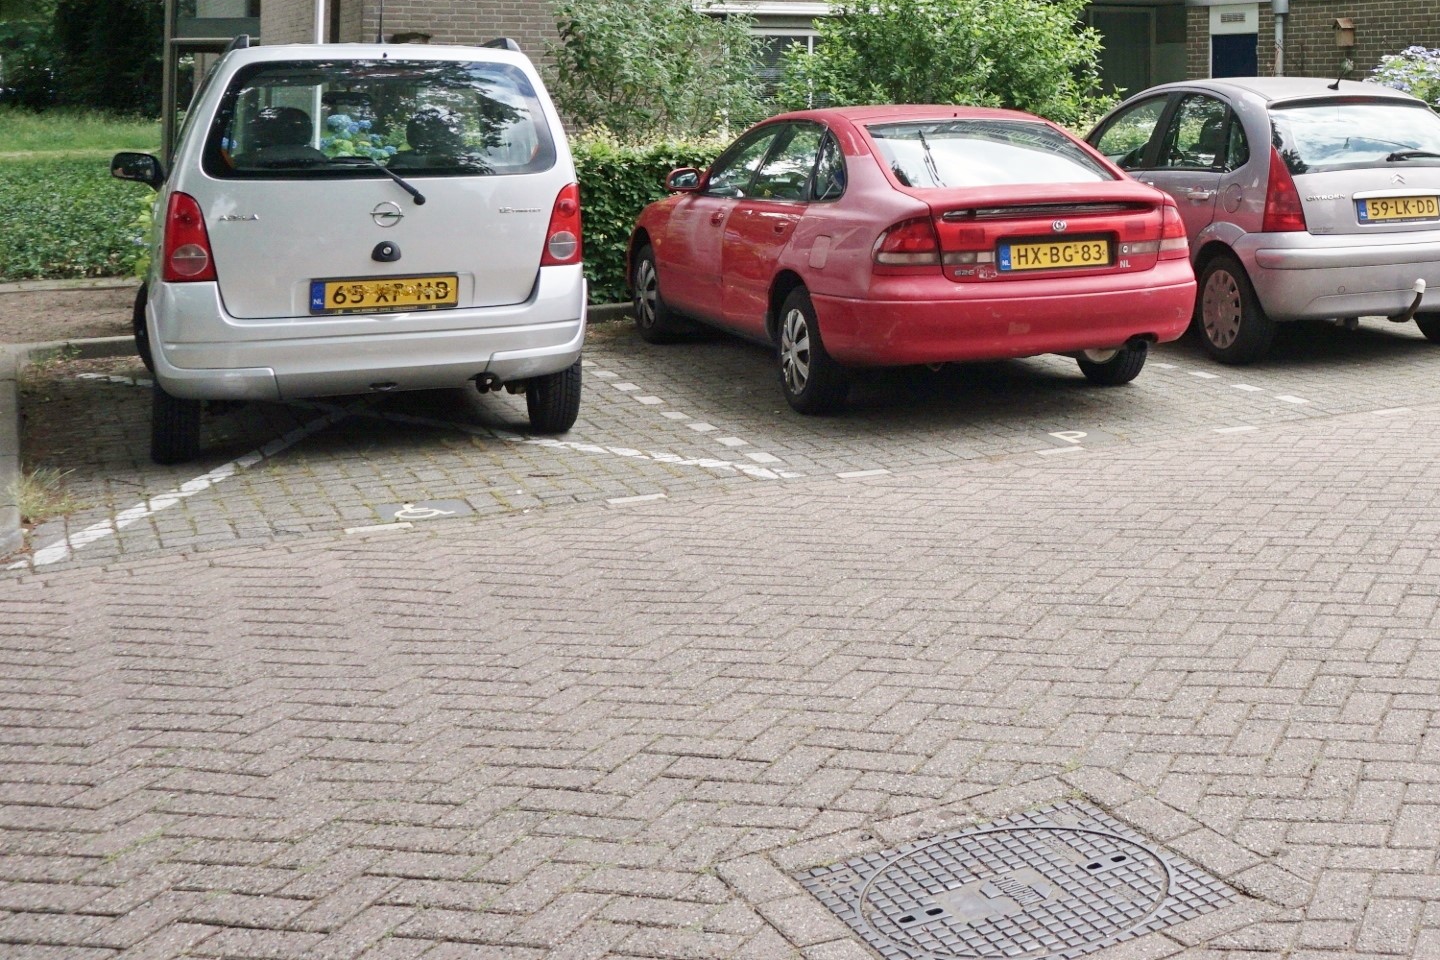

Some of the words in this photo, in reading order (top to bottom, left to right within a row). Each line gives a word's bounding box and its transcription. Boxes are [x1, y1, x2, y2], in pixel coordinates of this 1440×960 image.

[1371, 199, 1435, 216] 59-LK-DD
[1017, 244, 1102, 266] HX-BG-83
[1120, 260, 1131, 268] NL
